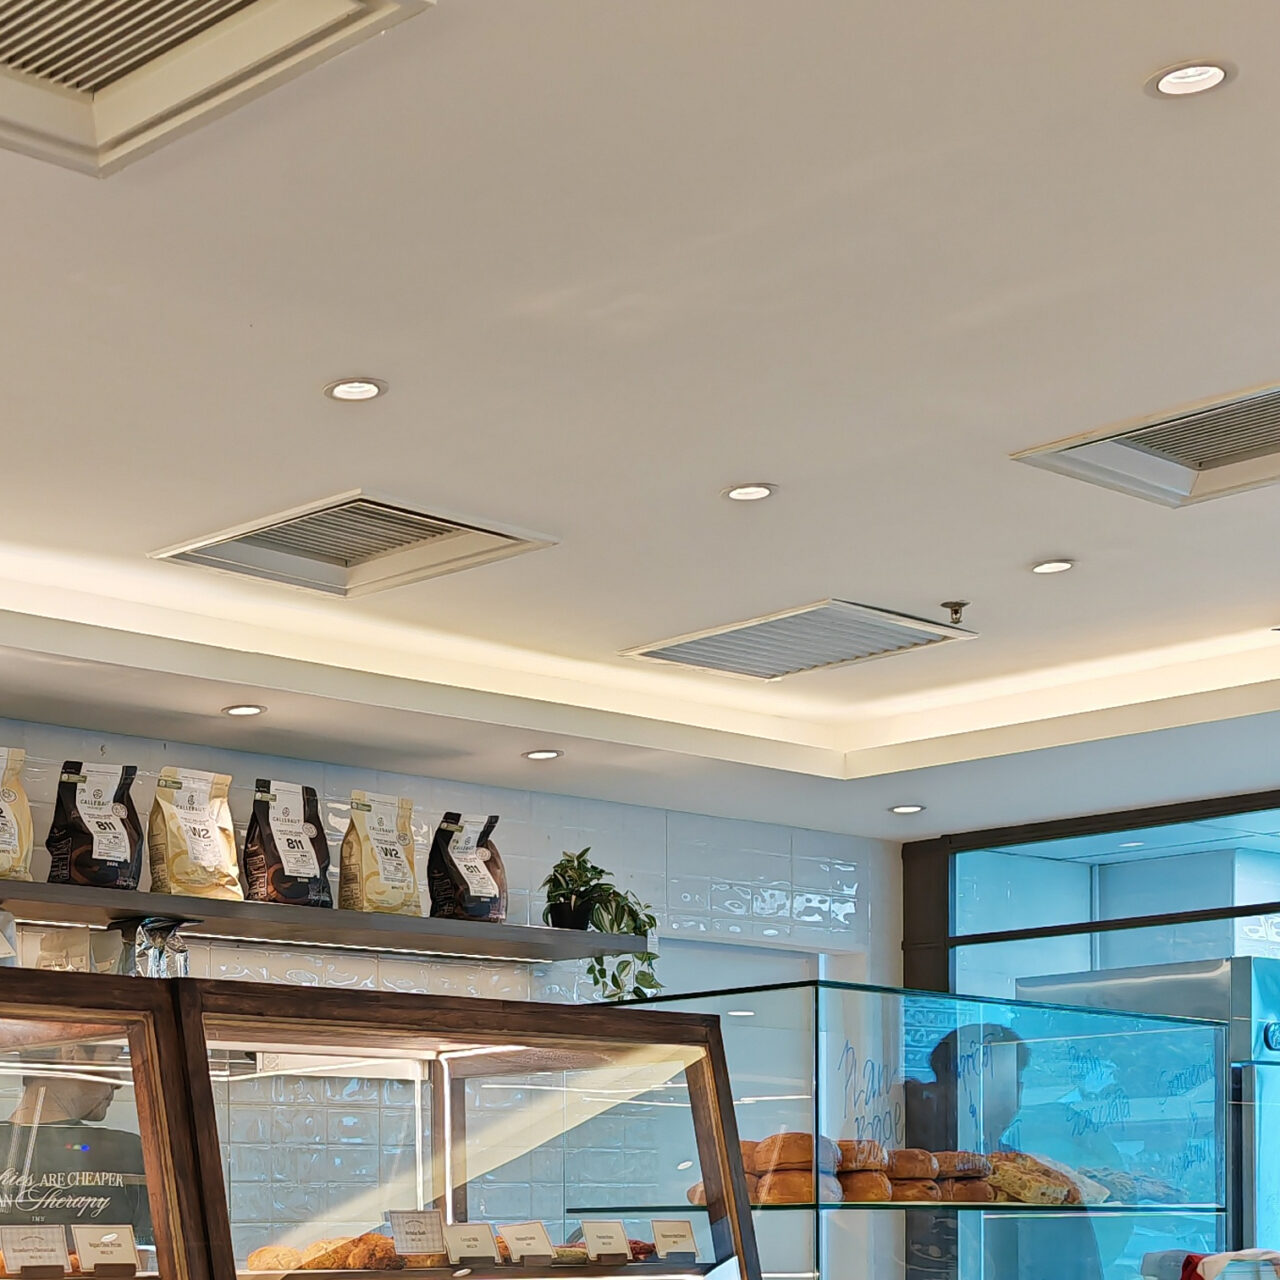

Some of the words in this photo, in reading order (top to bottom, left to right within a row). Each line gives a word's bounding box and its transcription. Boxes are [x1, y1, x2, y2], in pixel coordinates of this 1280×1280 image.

[95, 820, 117, 832] 811
[189, 825, 211, 840] W2
[286, 837, 305, 851] 811
[381, 846, 401, 859] W2
[464, 863, 482, 874] 811
[40, 1172, 66, 1187] ARE
[67, 1171, 124, 1190] CHEAPER
[15, 1183, 111, 1217] Therapy
